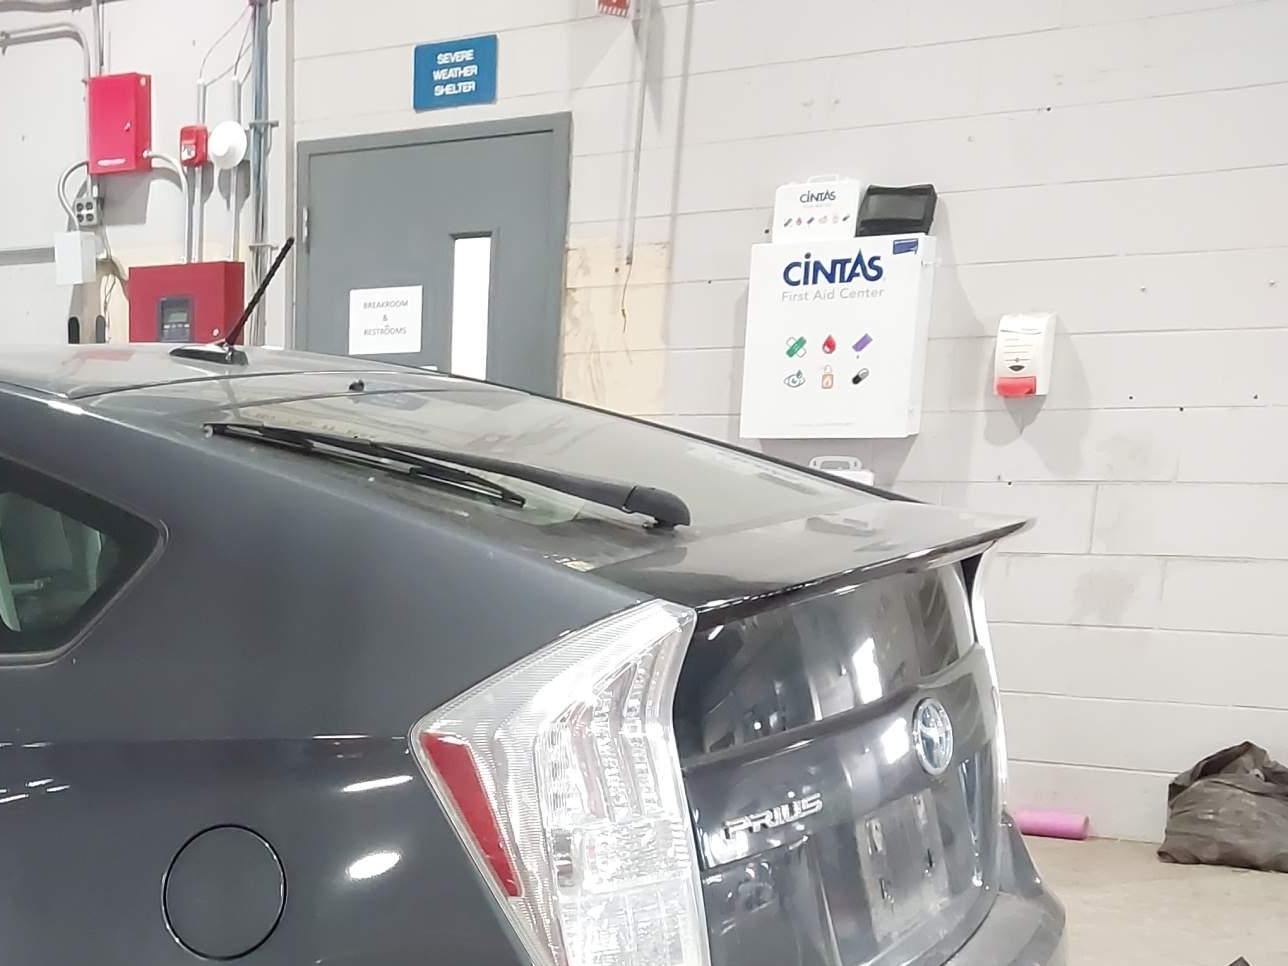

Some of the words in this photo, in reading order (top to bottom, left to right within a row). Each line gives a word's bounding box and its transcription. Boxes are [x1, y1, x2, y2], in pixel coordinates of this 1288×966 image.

[437, 49, 475, 65] SEVERE
[433, 64, 478, 81] WEATHER
[434, 80, 476, 96] SHELTER
[781, 290, 809, 302] First
[812, 287, 835, 301] Aid
[839, 286, 885, 299] Center
[363, 299, 409, 309] BREAKROOM
[382, 314, 388, 322] &
[363, 326, 407, 336] RESTROOMS
[724, 792, 823, 839] PRIUS
